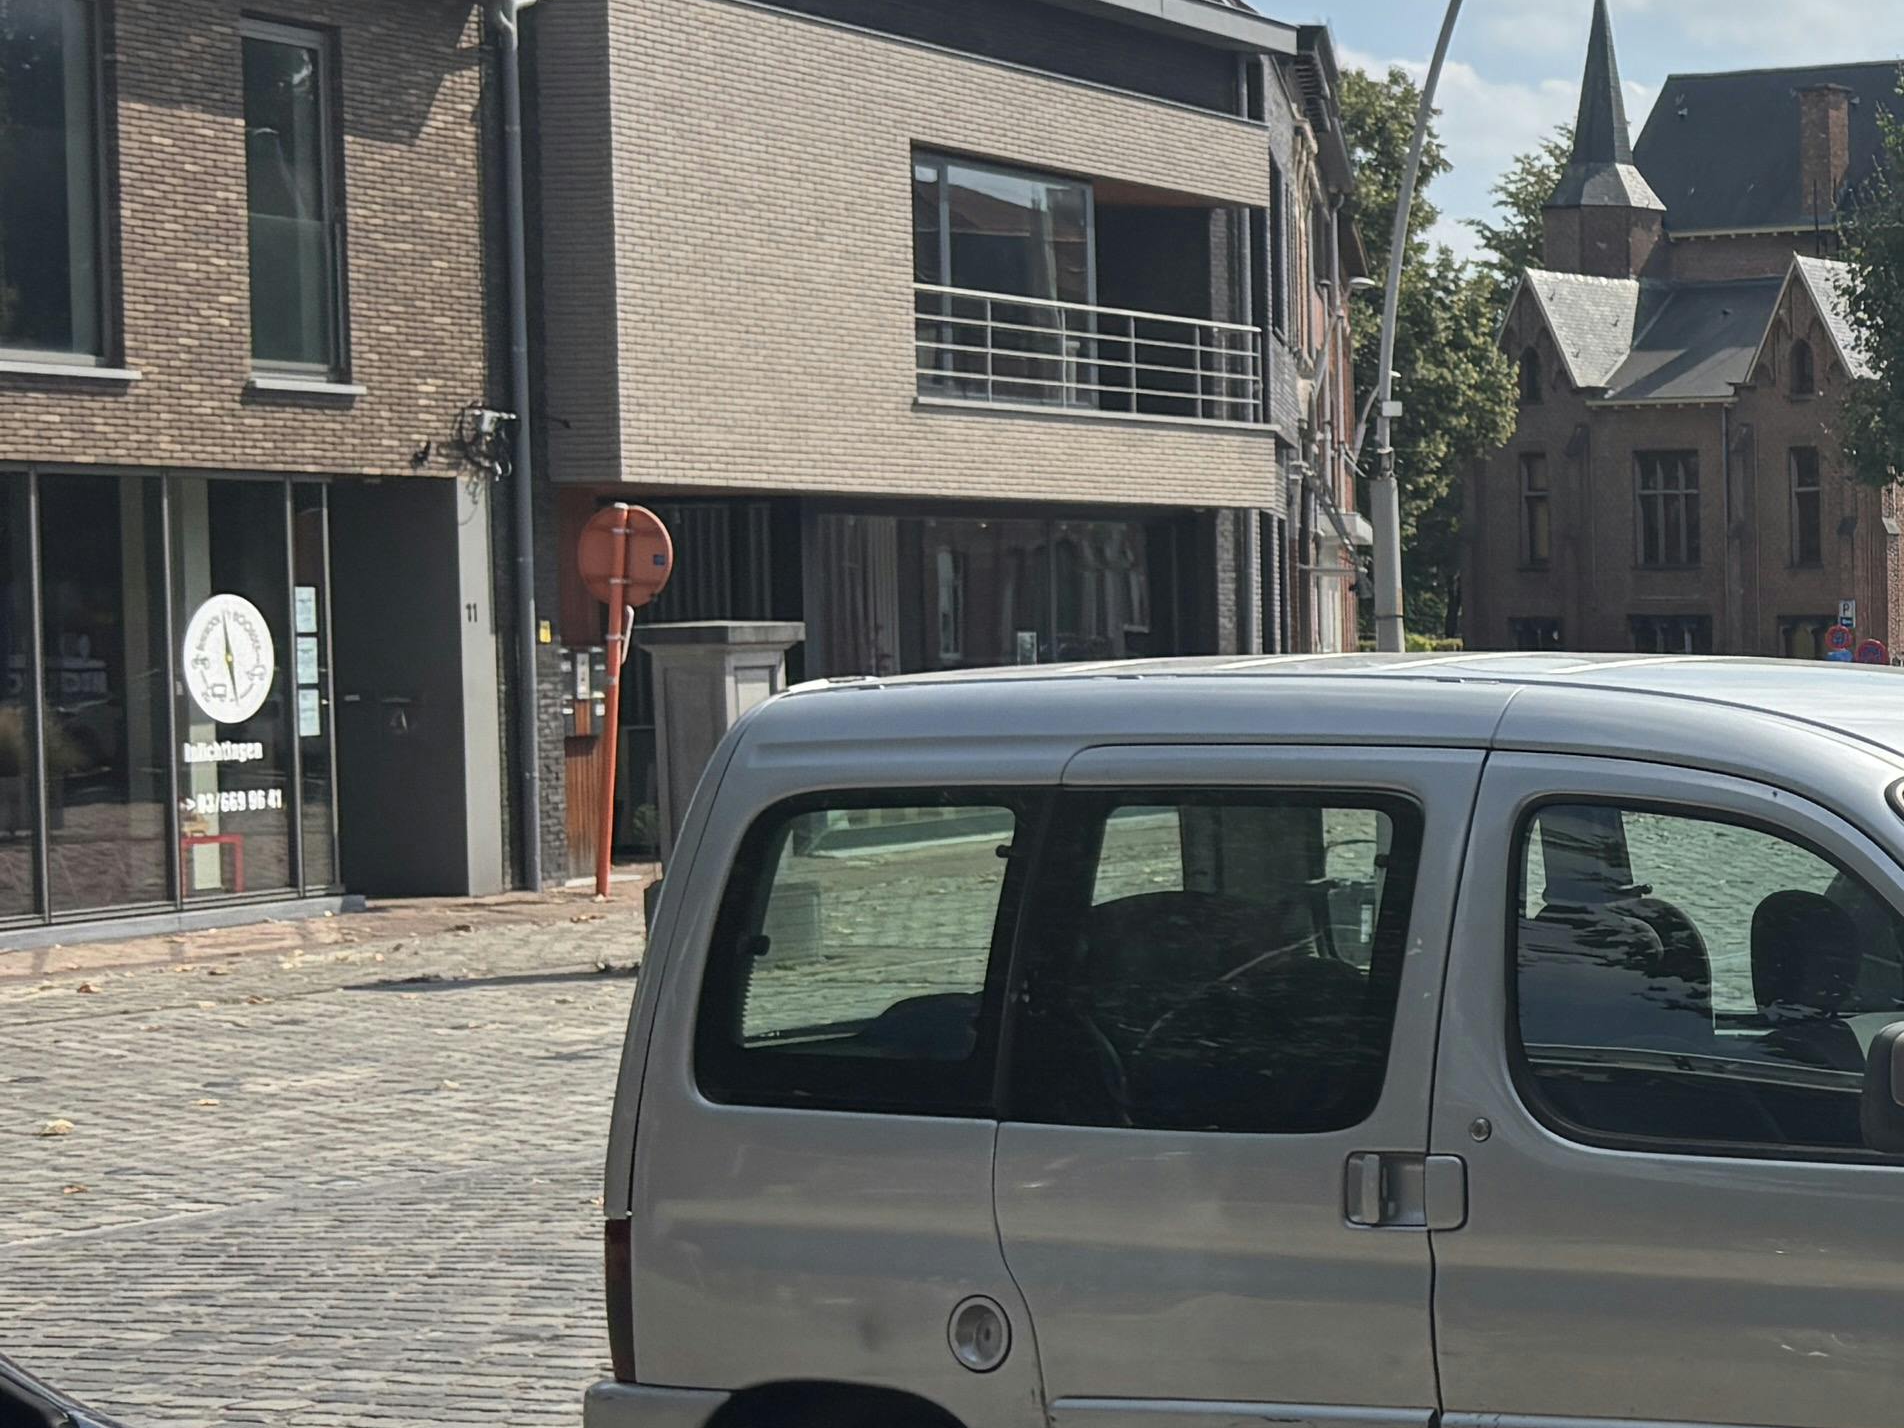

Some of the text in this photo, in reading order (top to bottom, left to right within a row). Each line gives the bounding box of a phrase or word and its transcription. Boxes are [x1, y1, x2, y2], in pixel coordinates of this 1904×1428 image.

[465, 602, 478, 623] 11
[1842, 603, 1850, 616] P
[183, 740, 264, 762] Inlichtingen
